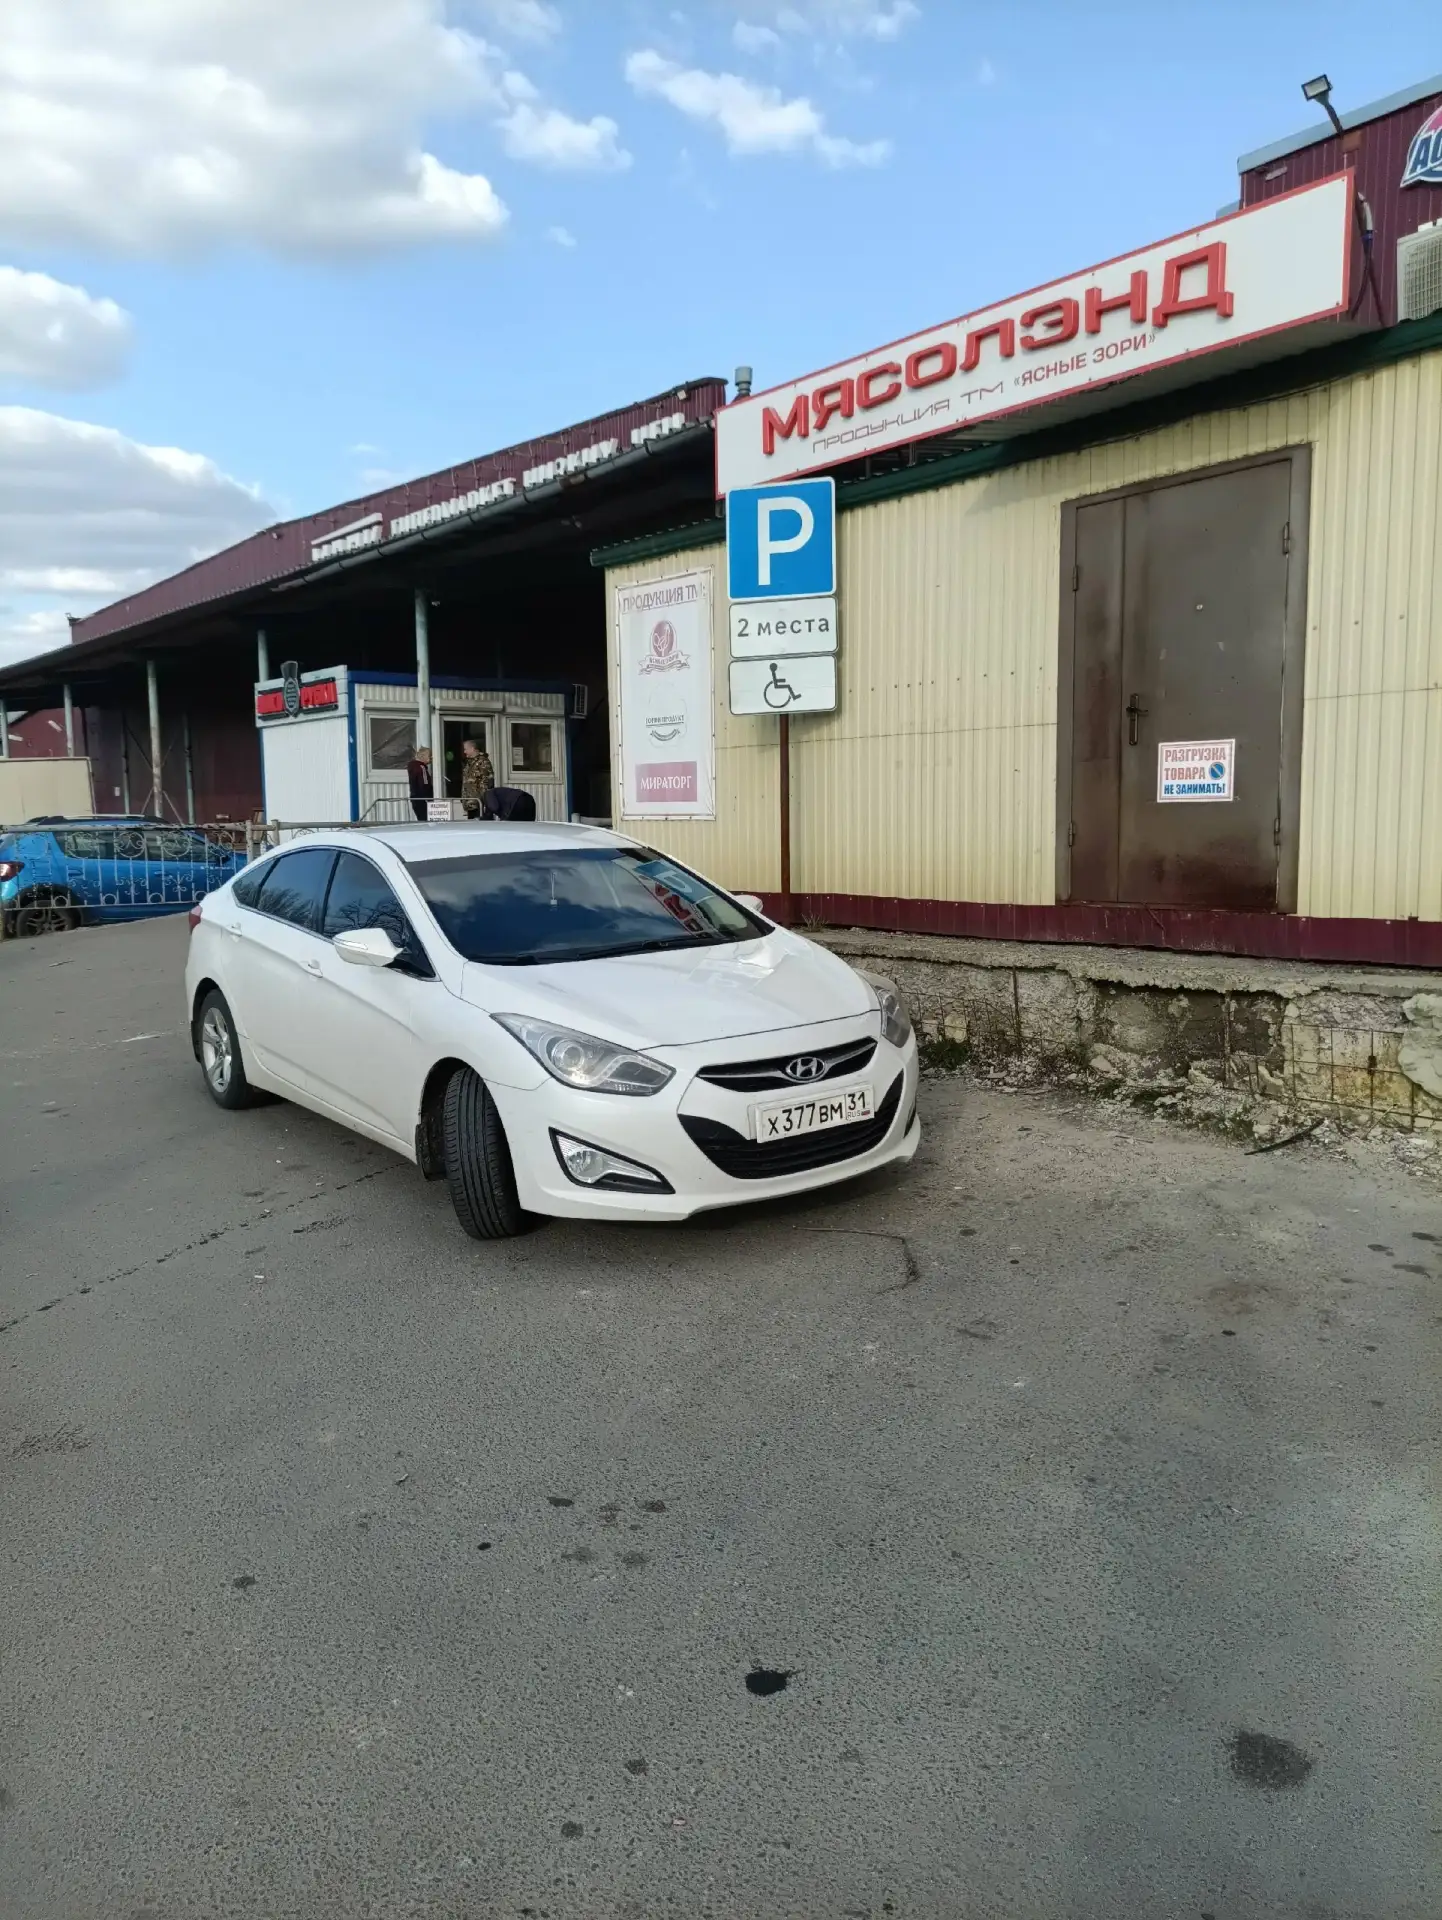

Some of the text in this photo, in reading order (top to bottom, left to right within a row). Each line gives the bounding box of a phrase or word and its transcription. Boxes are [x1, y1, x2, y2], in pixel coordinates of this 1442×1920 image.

[762, 241, 1234, 454] МЯСОЛЭНД
[813, 333, 1156, 453] ПРОДУКЦИЯ ТМ «ЯСНЫЕ ЗОРИ»
[757, 496, 814, 586] P
[623, 586, 683, 612] ПРОДУКЦИЯ
[737, 618, 830, 637] 2 места
[1165, 747, 1226, 762] РАЗГРУЗКА
[640, 775, 692, 790] МИРАТОРГ
[1164, 767, 1206, 780] ТОВАРА
[1164, 783, 1226, 795] НЕ ЗАНИМАТЬ!
[768, 1092, 866, 1136] Х377ВМ 31
